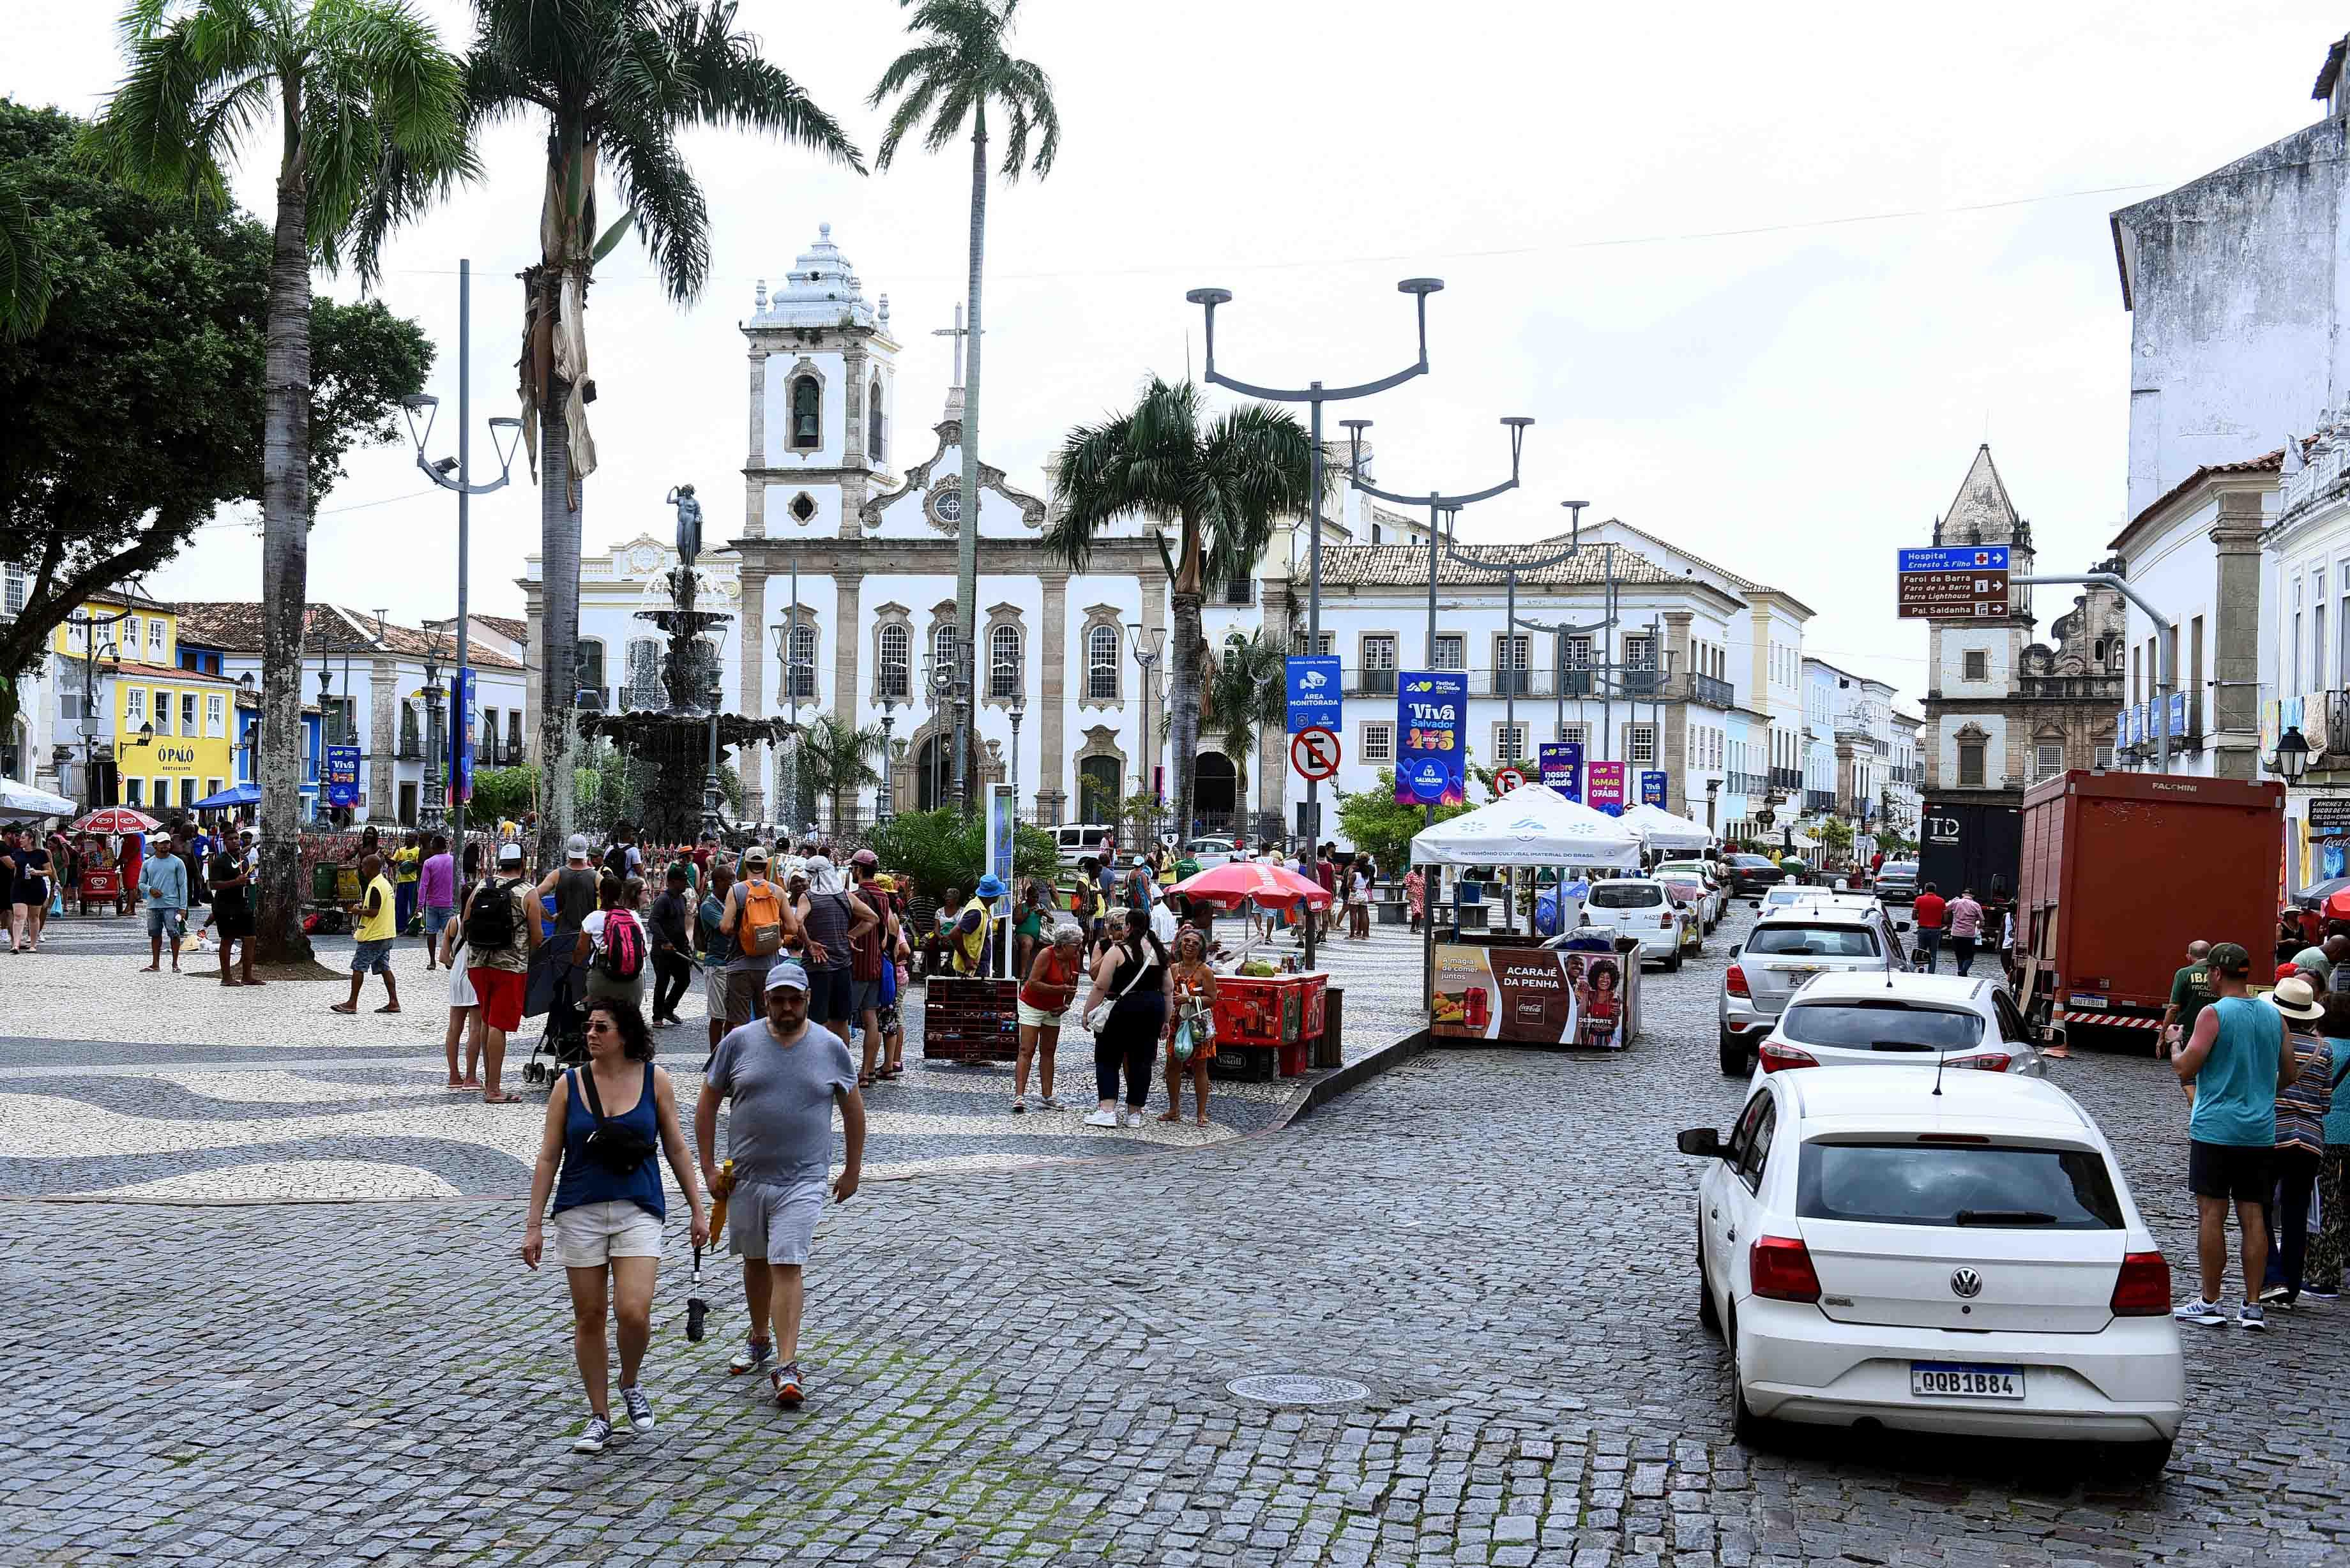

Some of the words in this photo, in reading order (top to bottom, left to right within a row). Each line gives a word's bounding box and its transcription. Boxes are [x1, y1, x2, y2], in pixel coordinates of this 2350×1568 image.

[1908, 552, 1946, 561] Hospital
[1409, 703, 1455, 720] Viva
[1411, 719, 1455, 728] Salvador
[158, 744, 166, 762] Ó
[1307, 737, 1326, 769] E
[332, 760, 354, 769] Viva
[1167, 835, 1173, 843] 8
[1441, 972, 1466, 980] juntos
[1506, 966, 1558, 977] ACARAJÉ
[1504, 977, 1520, 986] DA
[1522, 978, 1559, 989] PENHA
[1922, 1373, 2013, 1394] QQB1B84
